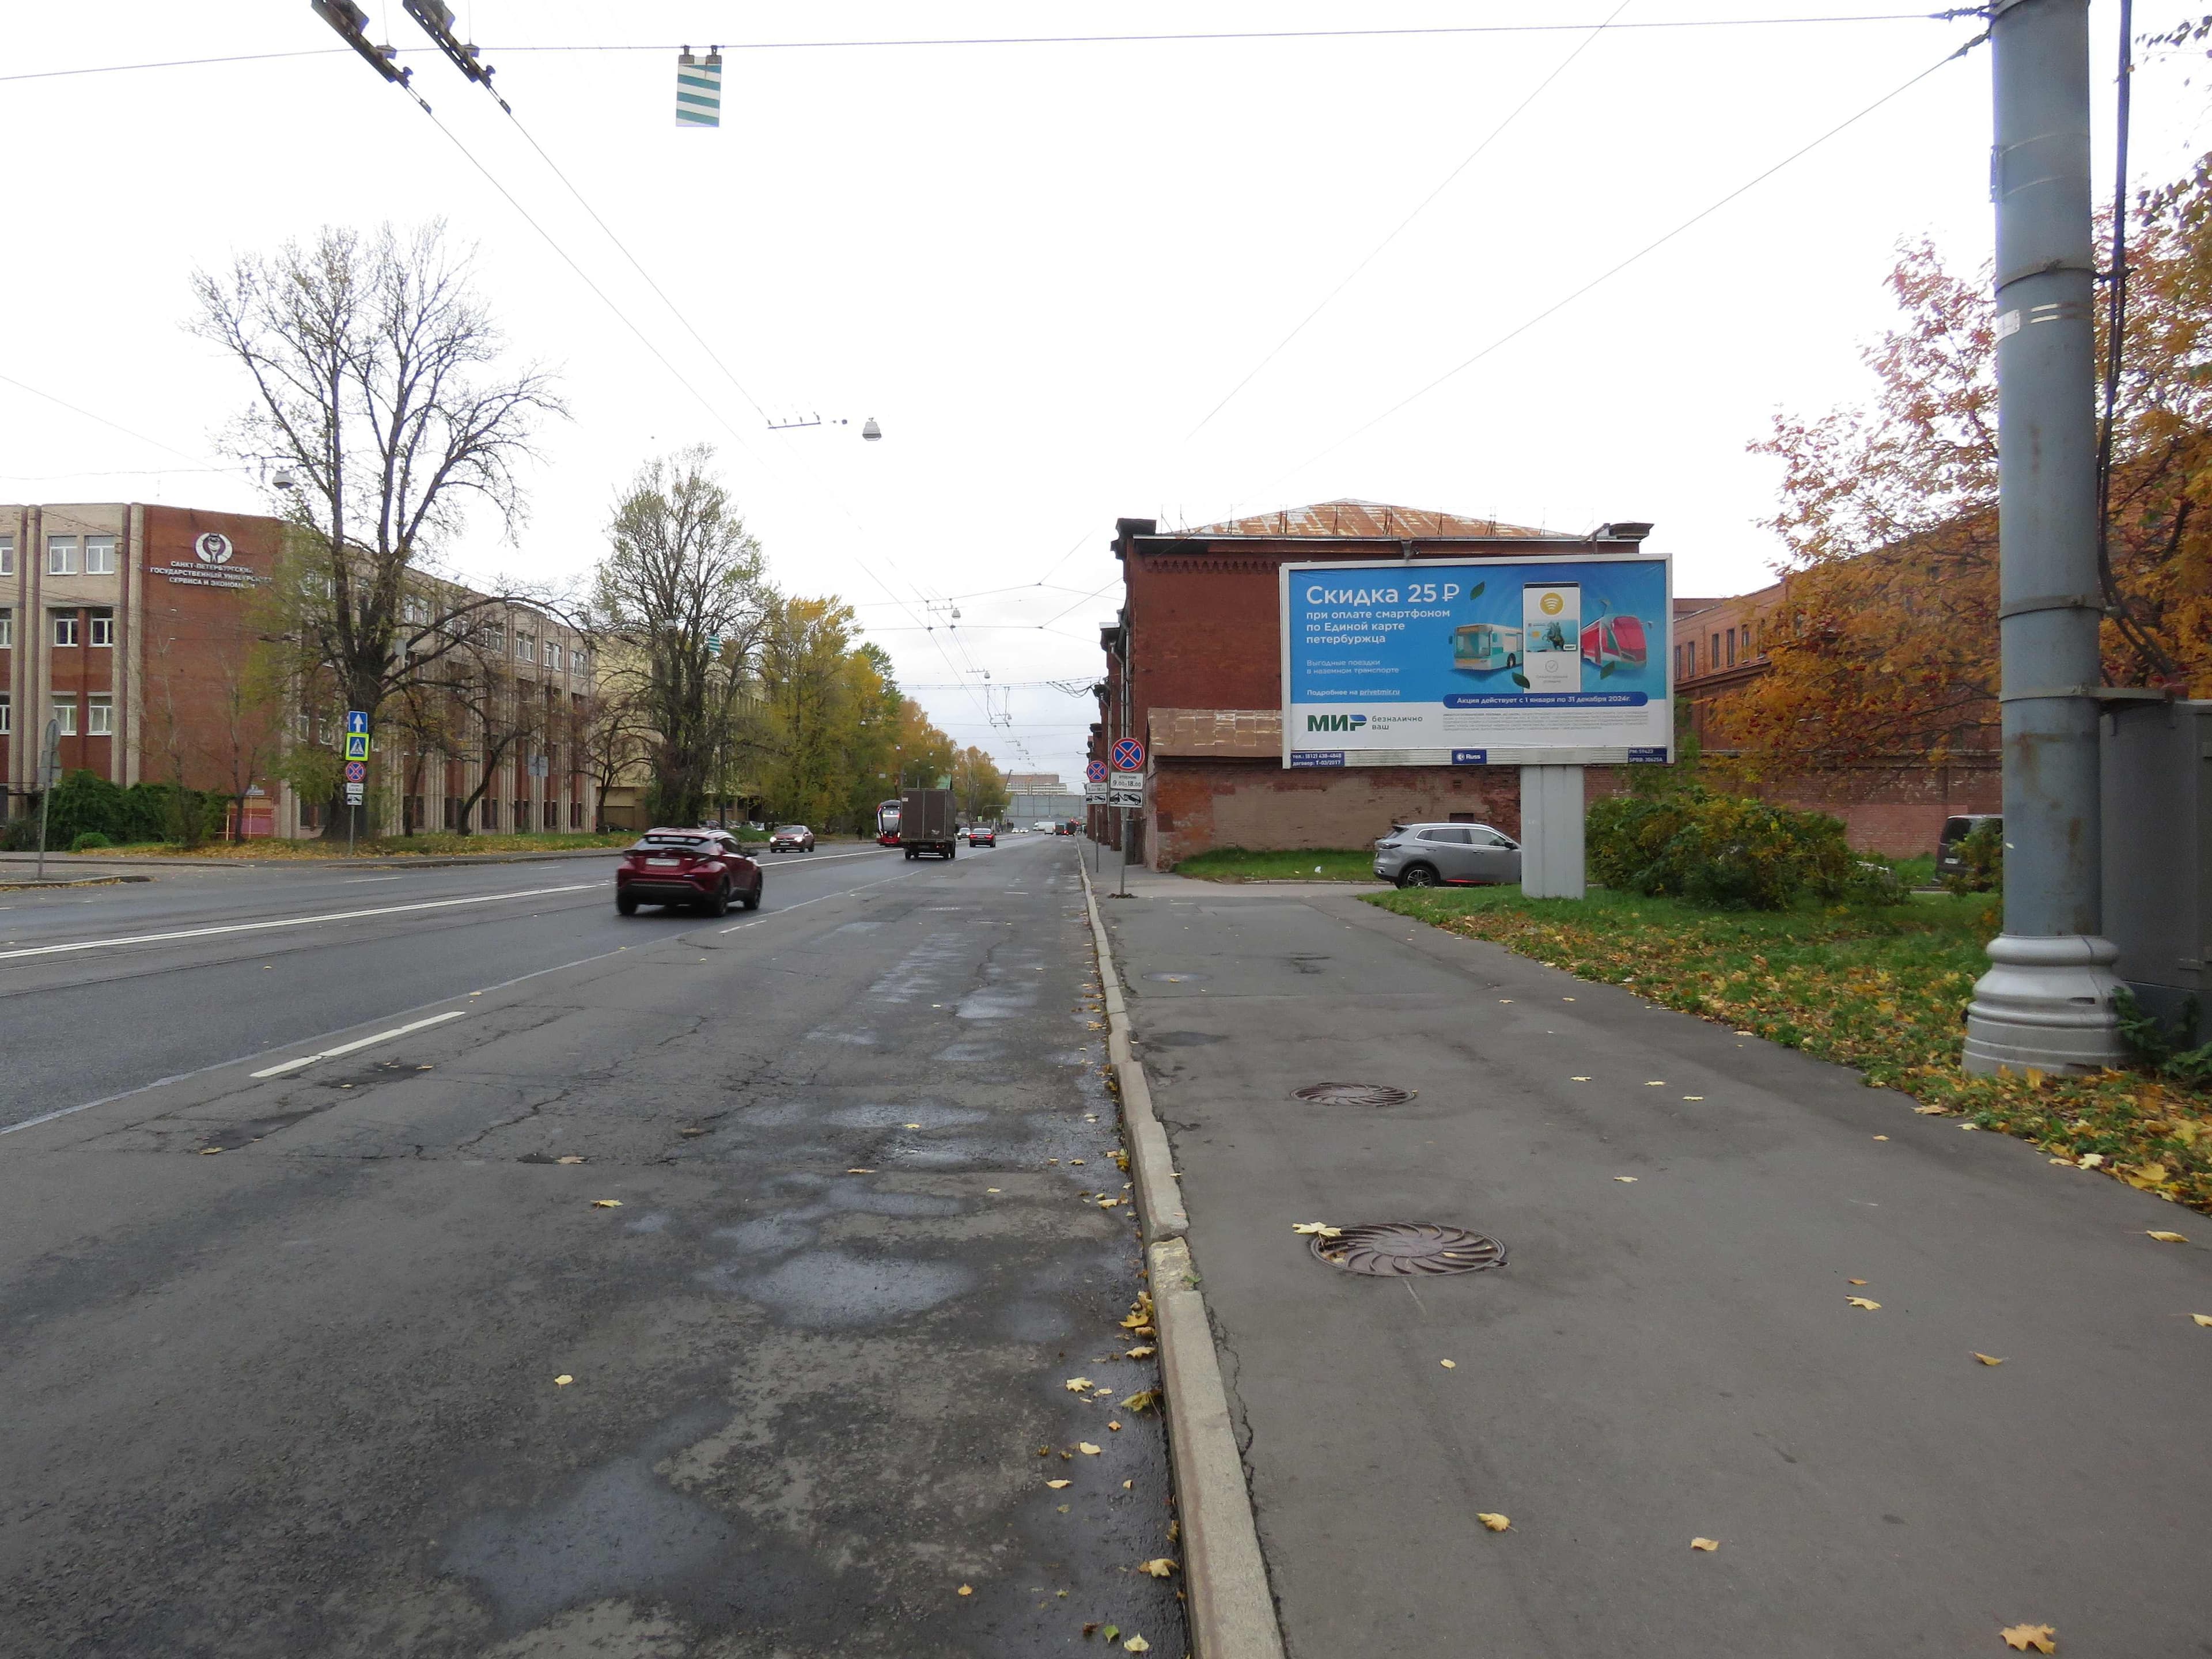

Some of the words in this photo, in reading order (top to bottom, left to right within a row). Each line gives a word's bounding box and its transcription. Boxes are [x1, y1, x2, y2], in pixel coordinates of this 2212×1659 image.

[150, 567, 222, 579] ГОСУДАРСТВЕННЫЙ
[169, 577, 203, 585] СЕРВИСА
[1306, 585, 1399, 607] Скидка
[1407, 584, 1437, 603] 25
[1306, 612, 1328, 620] при
[1331, 611, 1372, 619] оплате
[1375, 608, 1450, 620] смартфоном
[1325, 622, 1368, 632] Единой
[1372, 622, 1406, 632] карте
[1306, 634, 1386, 645] петербуржца
[1480, 696, 1517, 704] действует
[1576, 695, 1607, 703] декабря
[1307, 714, 1368, 732] МИР
